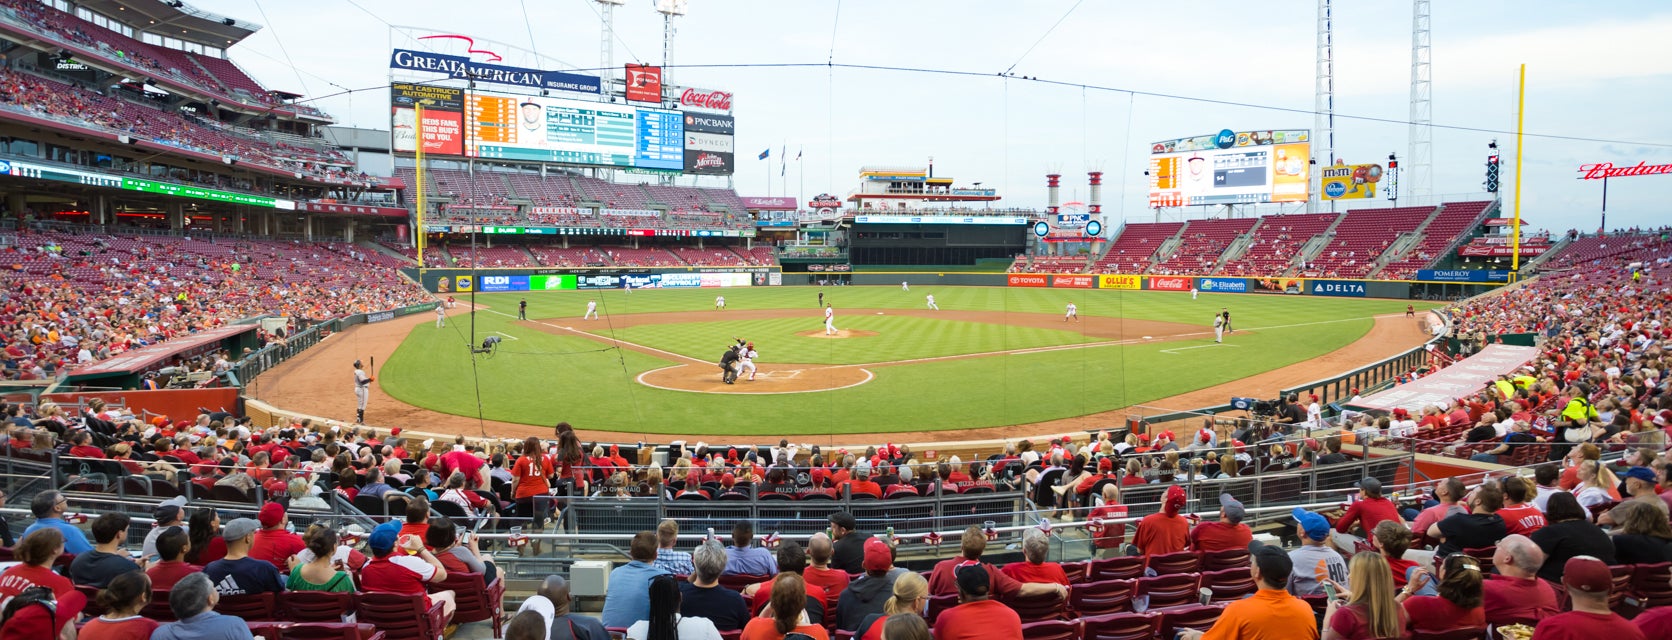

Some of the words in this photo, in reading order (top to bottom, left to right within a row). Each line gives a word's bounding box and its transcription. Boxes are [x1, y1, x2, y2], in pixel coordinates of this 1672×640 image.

[394, 52, 461, 72] GREAT
[453, 62, 543, 87] AMERICAN
[547, 81, 578, 90] INSURANCE
[579, 84, 597, 92] GROUP
[402, 91, 452, 99] AUTOMOTIVE
[681, 88, 733, 110] Coca-Cola
[694, 117, 711, 127] PNC
[712, 118, 733, 128] BANK
[698, 139, 729, 147] DYNEGY
[1218, 135, 1234, 143] P&G
[484, 276, 509, 285] RDI
[1157, 279, 1183, 289] Coca-Cola
[1219, 281, 1245, 289] Elizabeth
[1327, 284, 1365, 293] DELTA
